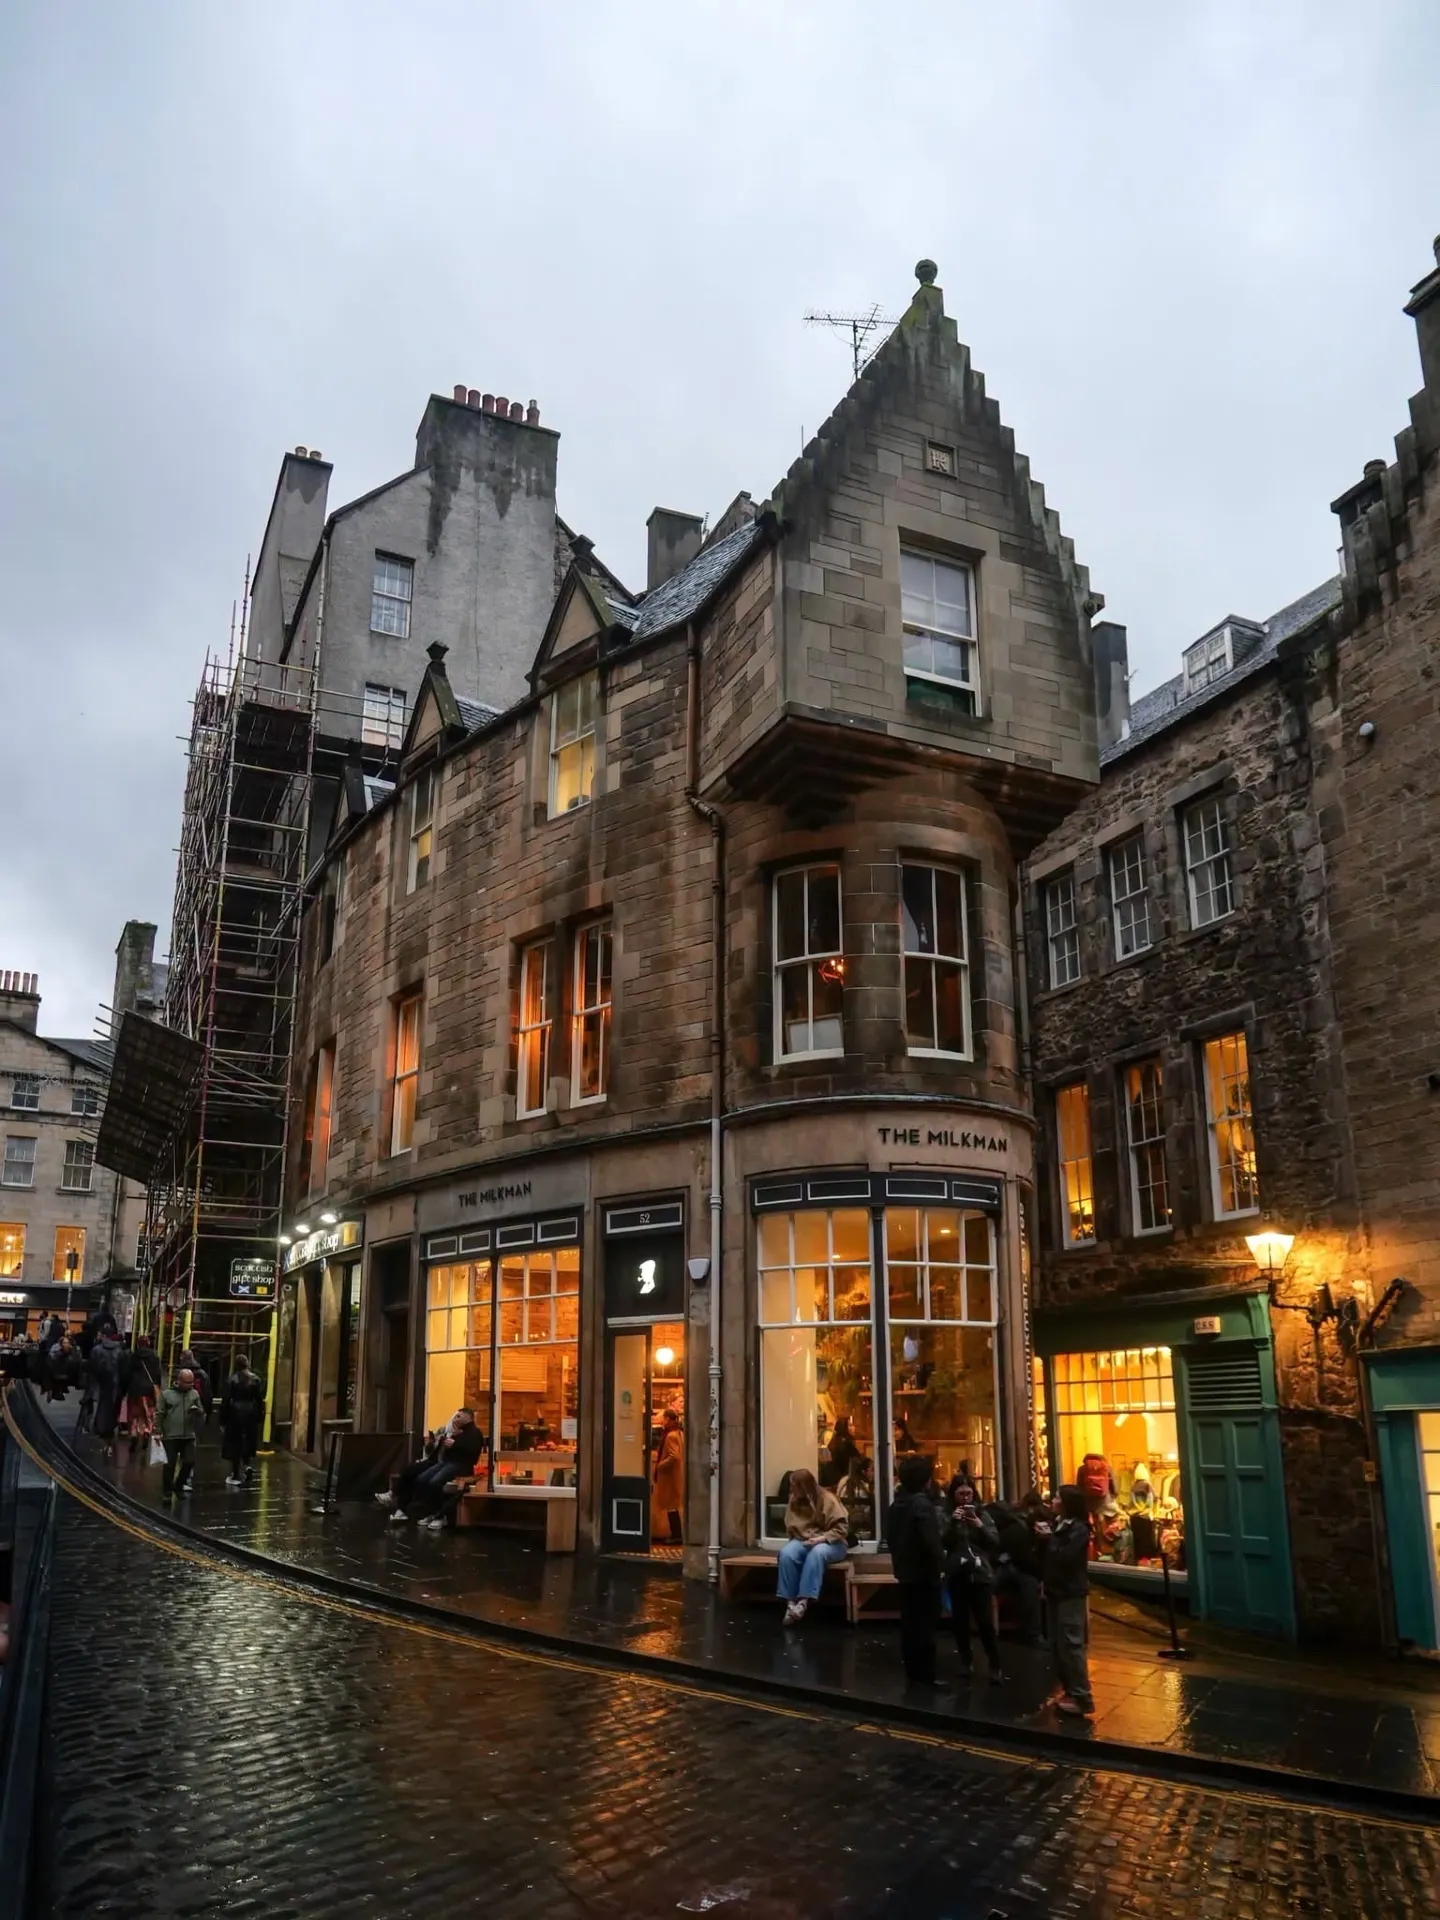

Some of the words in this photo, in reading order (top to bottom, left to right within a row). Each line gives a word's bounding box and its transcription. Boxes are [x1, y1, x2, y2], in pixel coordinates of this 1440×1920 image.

[878, 1128, 920, 1145] THE
[928, 1130, 1007, 1152] MILKMAN
[459, 1191, 477, 1208] THE
[479, 1180, 532, 1205] MILKMAN
[640, 1212, 650, 1224] 52
[252, 1274, 275, 1285] shop
